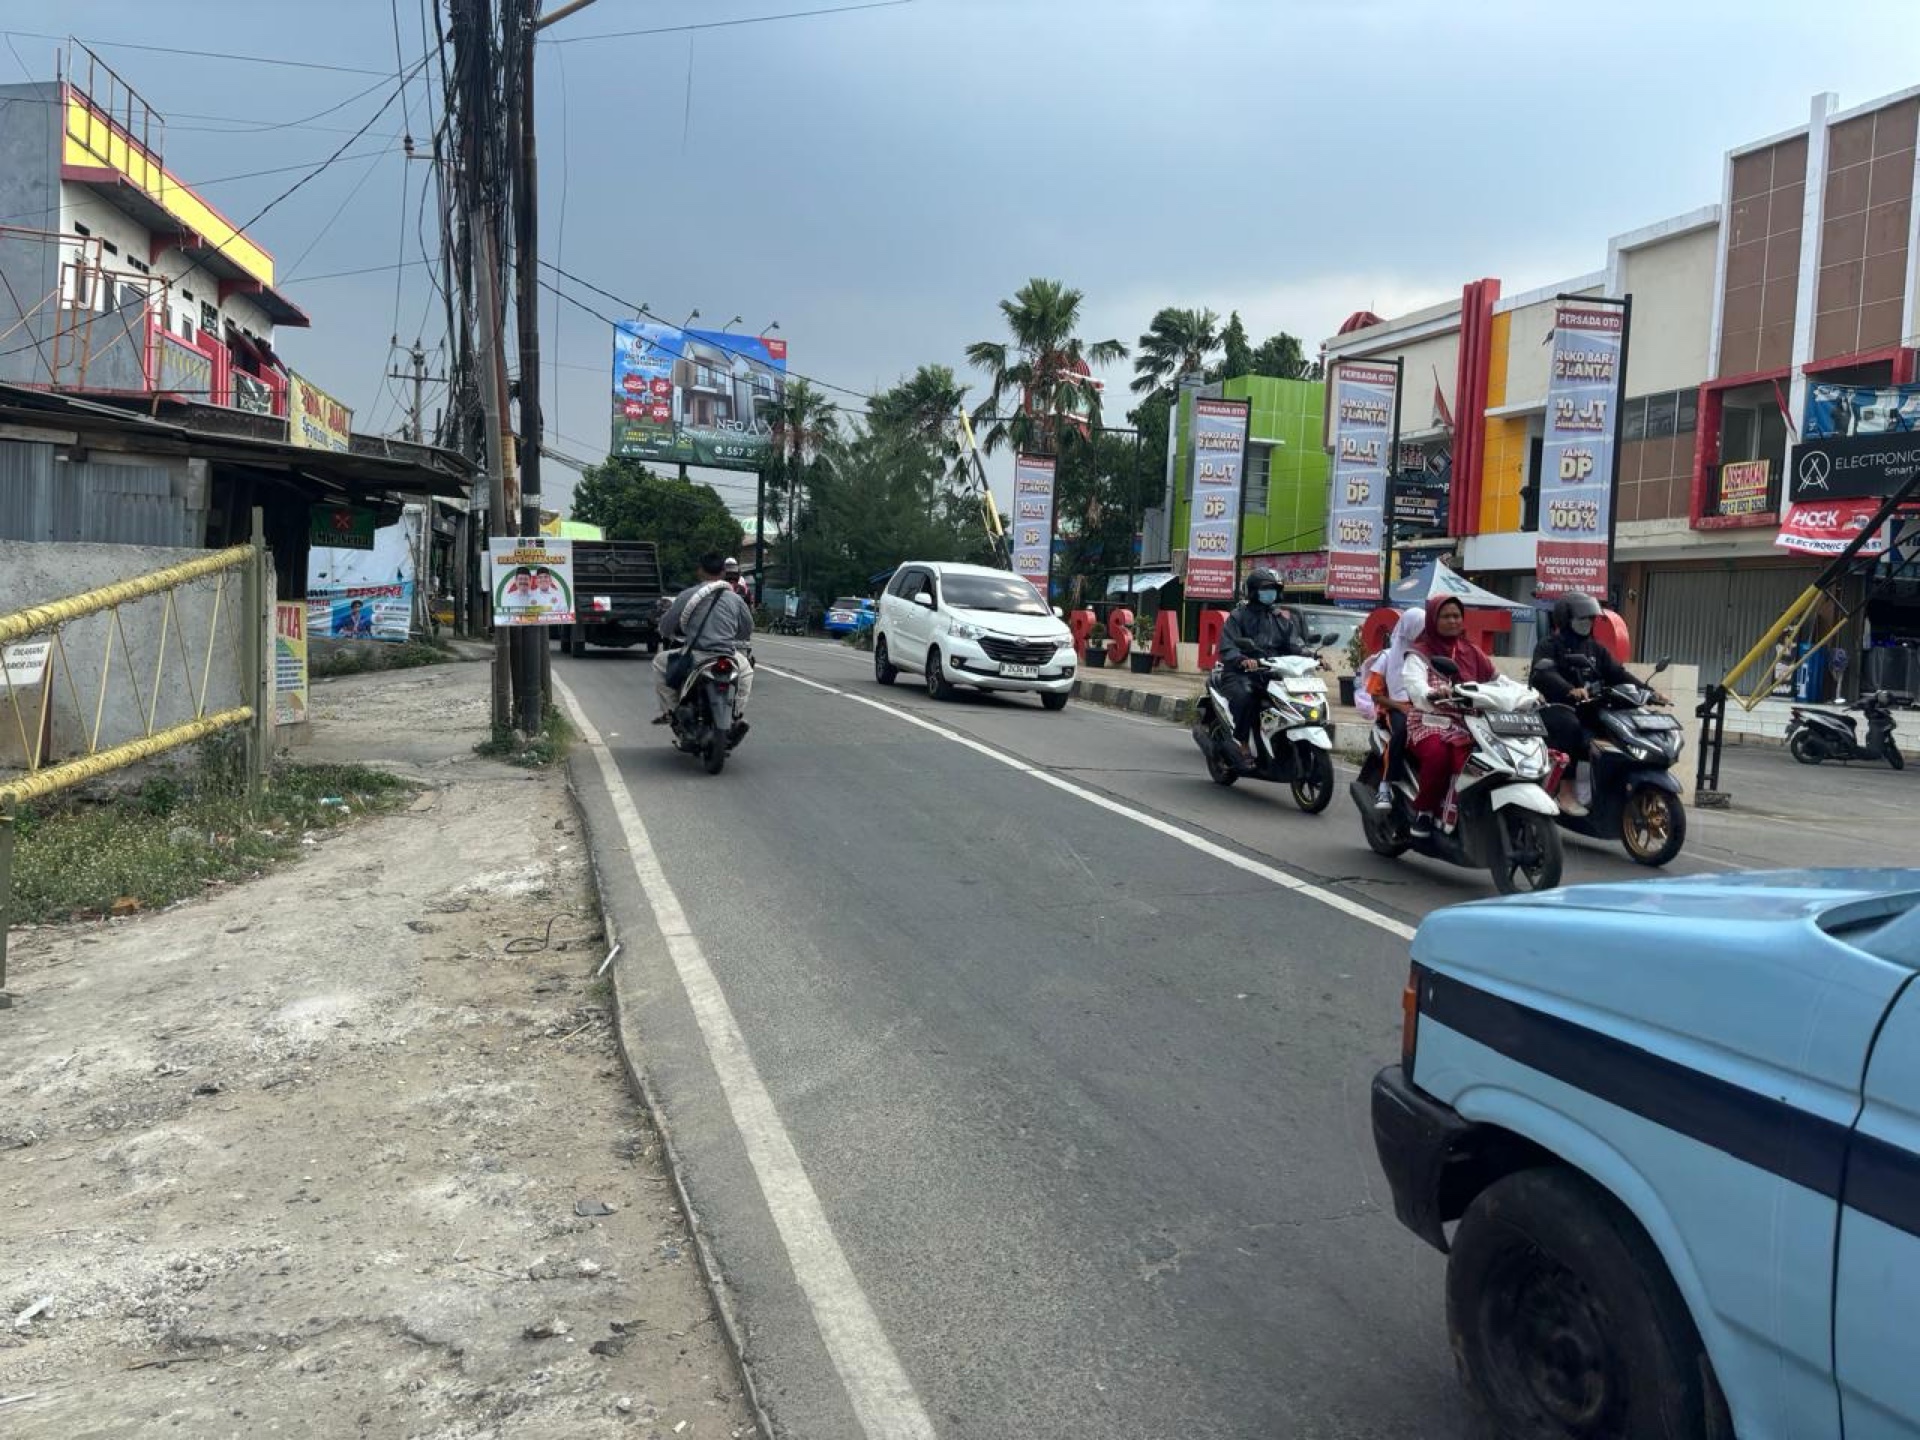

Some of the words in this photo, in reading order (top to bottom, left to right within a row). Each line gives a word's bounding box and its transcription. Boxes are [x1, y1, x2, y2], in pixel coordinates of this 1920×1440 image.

[1560, 313, 1601, 326] PERSADA
[1603, 317, 1619, 328] OTO
[1340, 370, 1377, 380] PERSADA
[1556, 363, 1565, 377] 2
[1580, 400, 1606, 420] JT
[1341, 437, 1357, 454] 10
[1560, 457, 1594, 480] DP
[1884, 465, 1912, 476] Smart
[1347, 484, 1369, 503] DP
[1204, 501, 1225, 518] DP
[1549, 509, 1598, 530] 100%
[1791, 510, 1839, 527] HOCK
[1339, 527, 1372, 544] 100%
[1196, 537, 1228, 552] 100%
[1538, 556, 1584, 567] LANGSUNG
[1545, 566, 1597, 577] DEVELOPER
